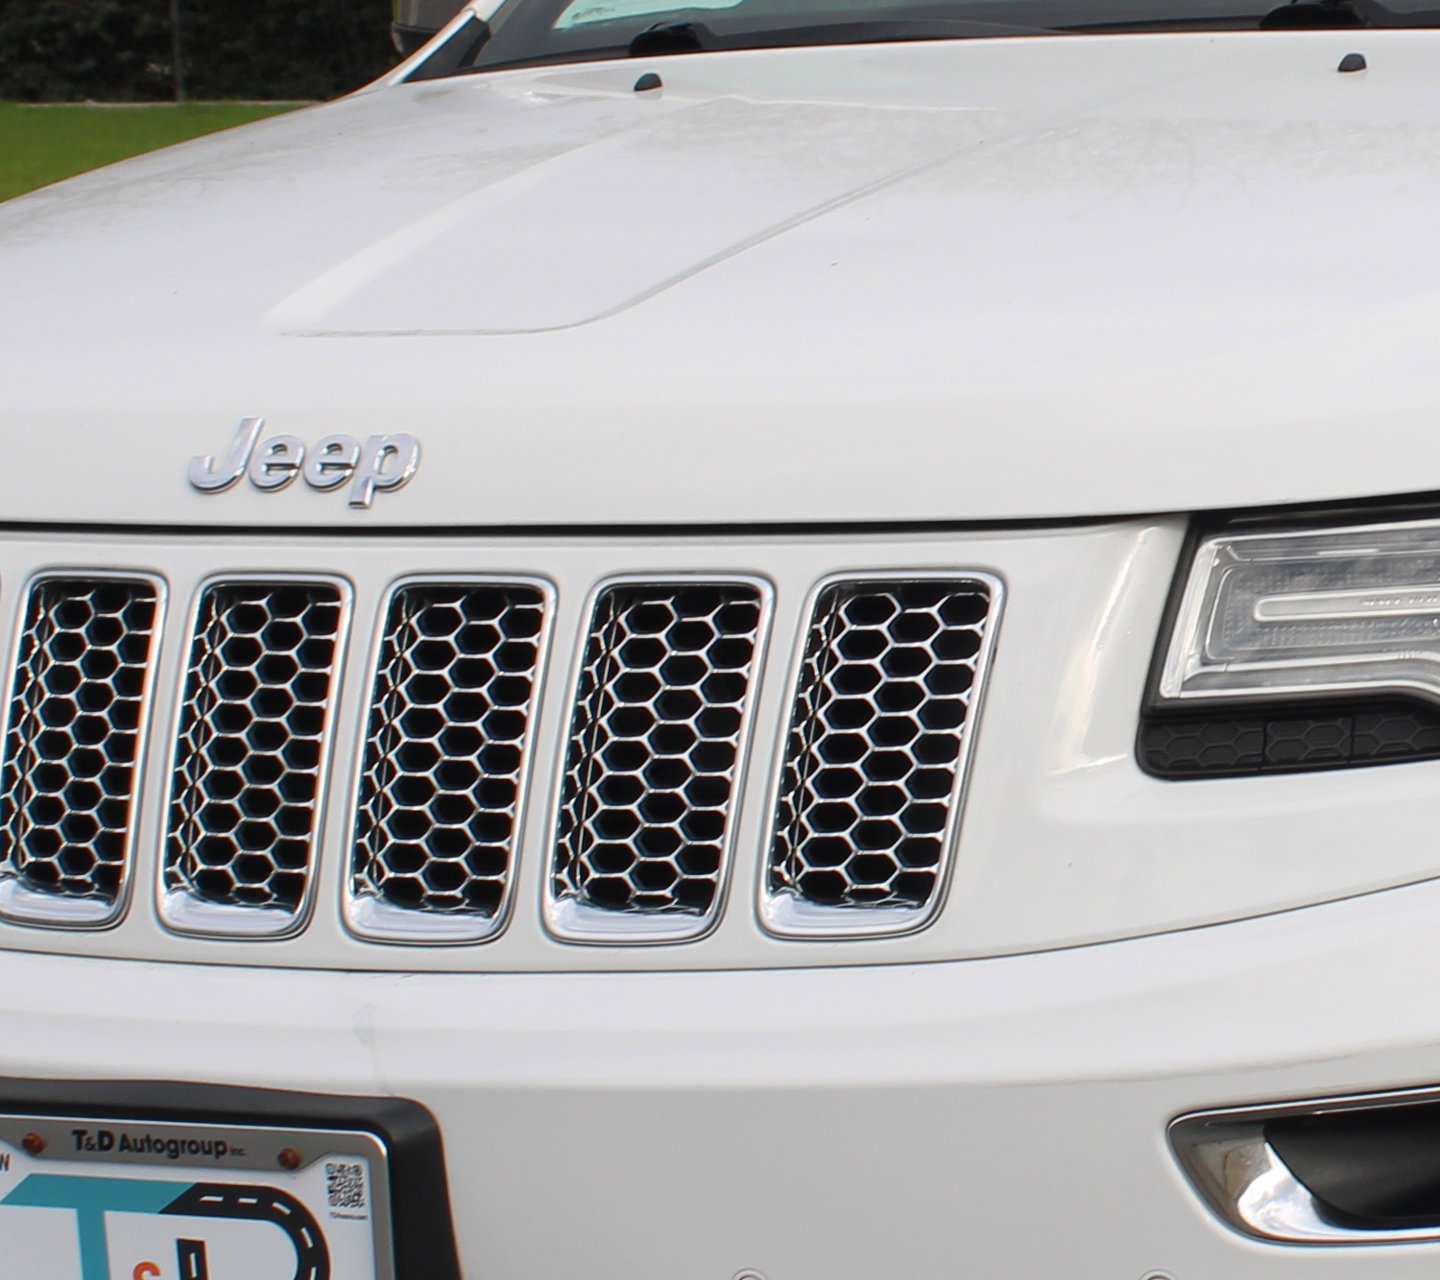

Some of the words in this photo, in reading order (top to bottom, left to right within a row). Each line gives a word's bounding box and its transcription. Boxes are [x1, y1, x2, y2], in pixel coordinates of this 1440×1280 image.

[187, 417, 421, 510] Jeep
[72, 1129, 115, 1152] T&D
[118, 1132, 228, 1160] Autogroup
